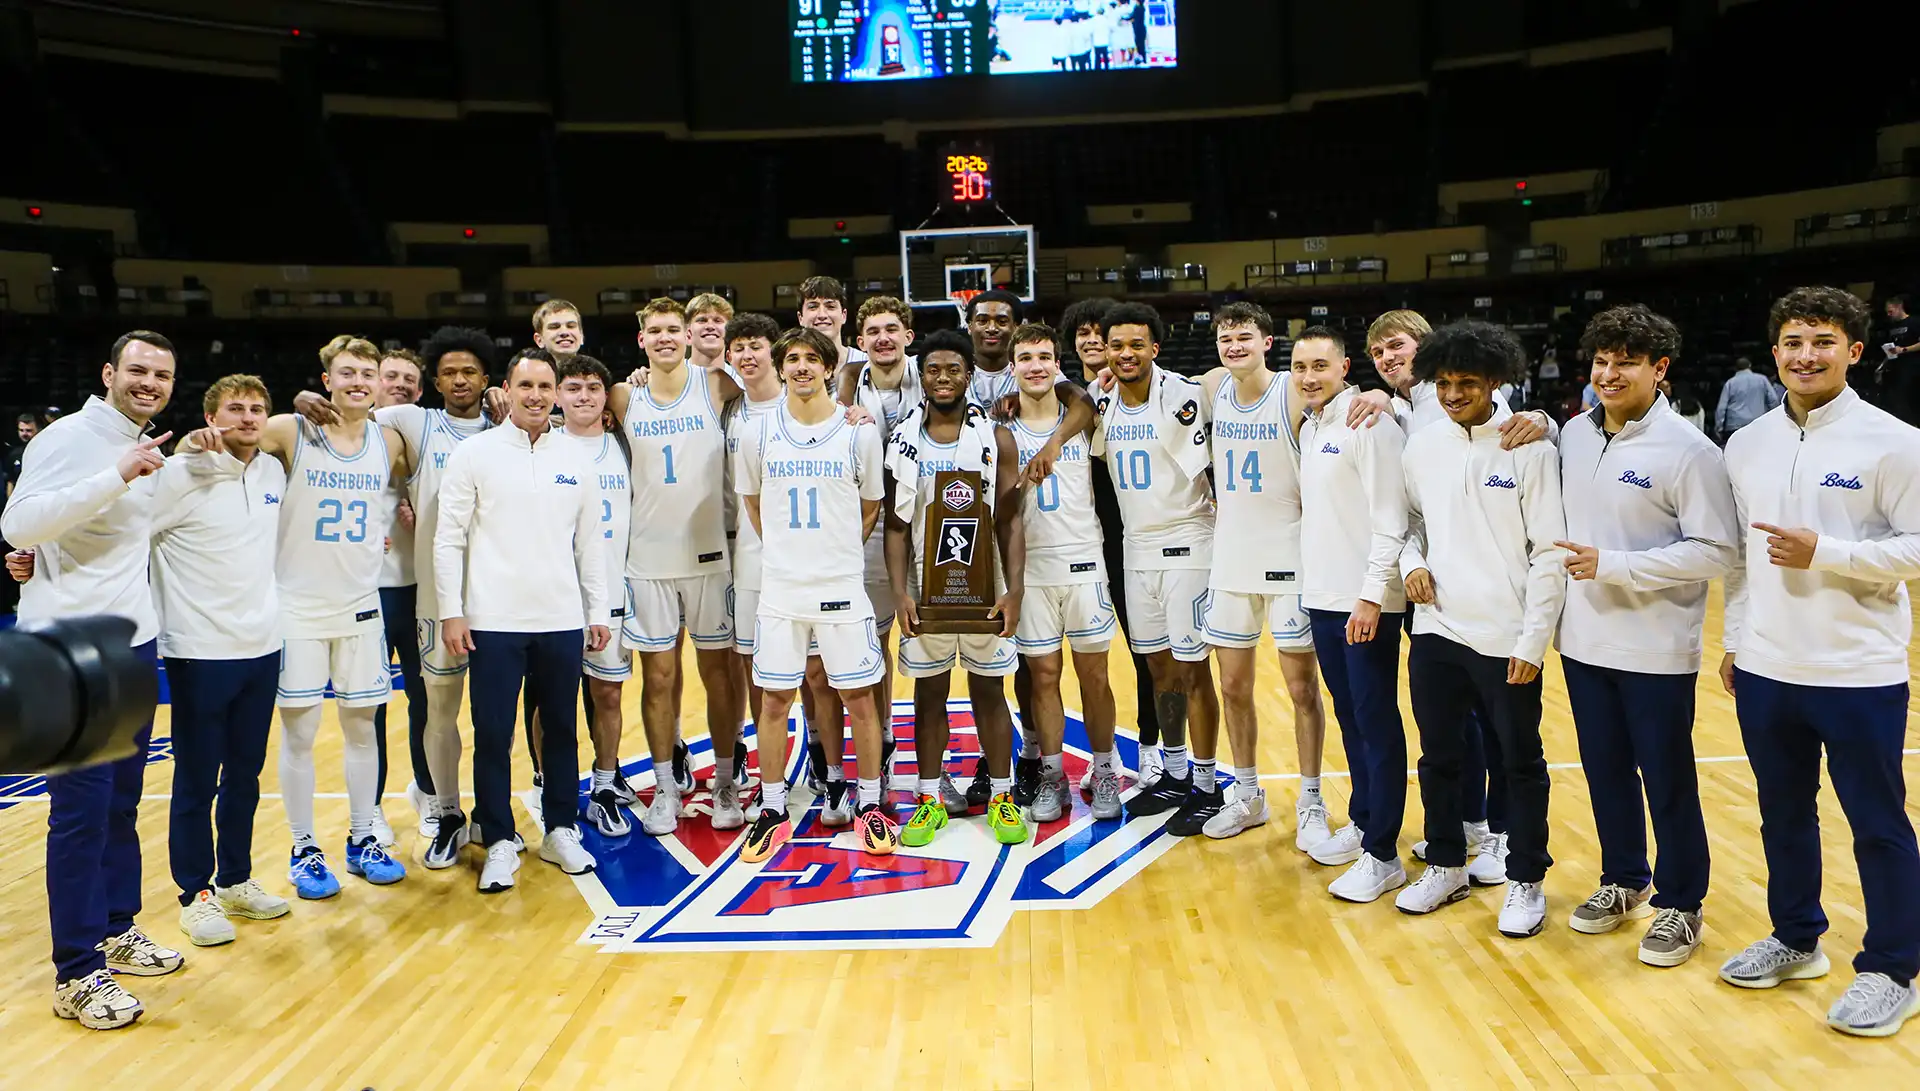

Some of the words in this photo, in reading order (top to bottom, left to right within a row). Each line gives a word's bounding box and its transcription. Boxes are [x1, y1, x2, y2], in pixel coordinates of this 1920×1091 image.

[947, 156, 988, 172] 20:26
[953, 173, 984, 200] 30
[1306, 239, 1326, 251] 135
[632, 415, 704, 437] WASHBURN
[1215, 420, 1278, 440] WASHBURN
[1321, 442, 1340, 454] Bods
[662, 445, 677, 484] 1
[767, 461, 844, 478] WASHBURN
[1115, 450, 1152, 490] 10
[1225, 450, 1263, 492] 14
[306, 469, 381, 490] WASHBURN
[555, 474, 578, 485] Bods
[1484, 475, 1517, 489] Bods
[1618, 470, 1653, 489] Bods
[1820, 473, 1864, 491] Bods
[946, 490, 971, 499] MIAA
[1036, 473, 1060, 512] 0
[788, 487, 820, 529] 11
[315, 498, 368, 542] 23
[590, 912, 640, 939] TM
